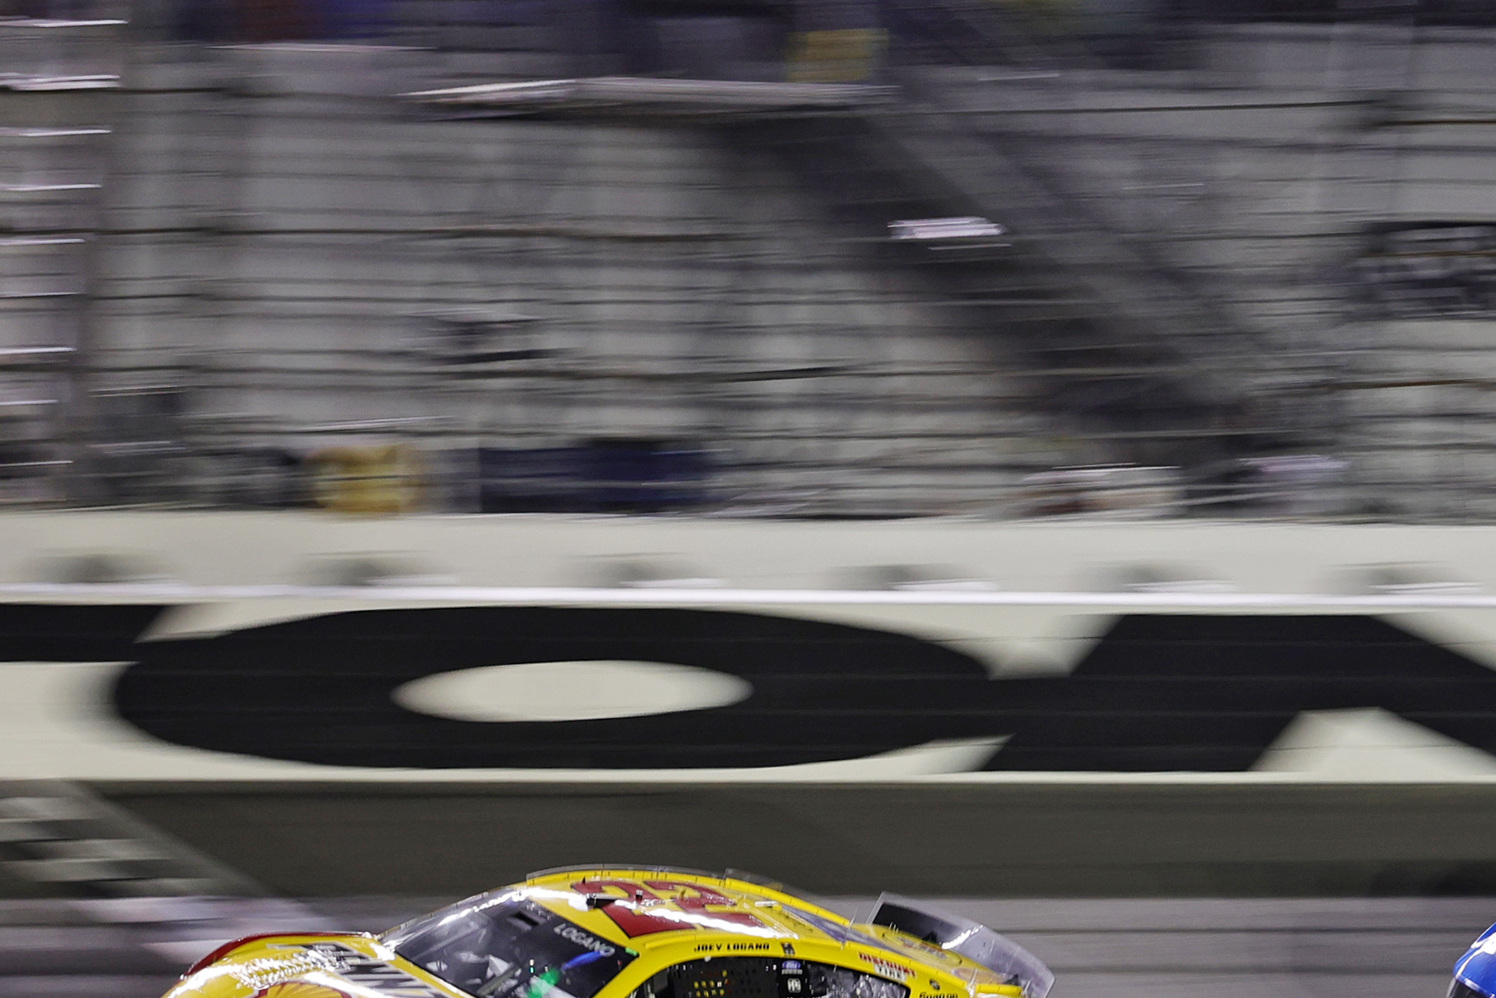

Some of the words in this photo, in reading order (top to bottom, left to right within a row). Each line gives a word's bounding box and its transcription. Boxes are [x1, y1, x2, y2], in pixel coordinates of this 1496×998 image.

[570, 880, 772, 940] 22
[553, 922, 616, 958] LOGANO
[694, 942, 723, 952] JOEY
[726, 942, 771, 952] LOGANO
